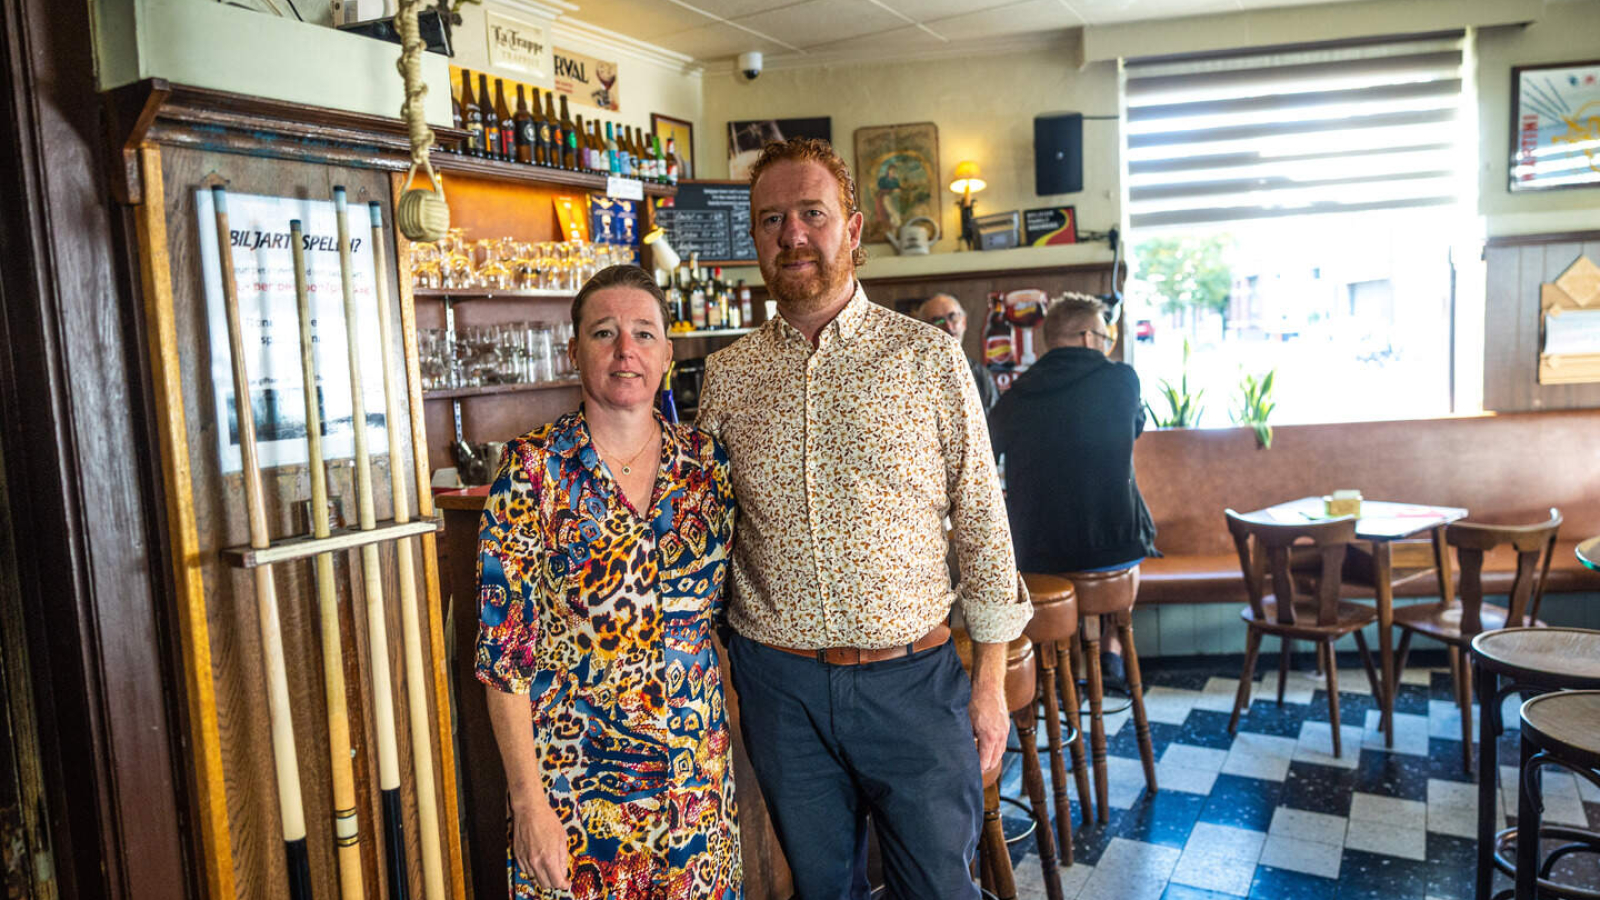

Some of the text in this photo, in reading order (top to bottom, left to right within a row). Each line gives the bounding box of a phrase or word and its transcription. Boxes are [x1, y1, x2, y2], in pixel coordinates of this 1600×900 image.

[490, 24, 543, 55] La Trappe
[230, 229, 362, 253] BILJART SPEL?
